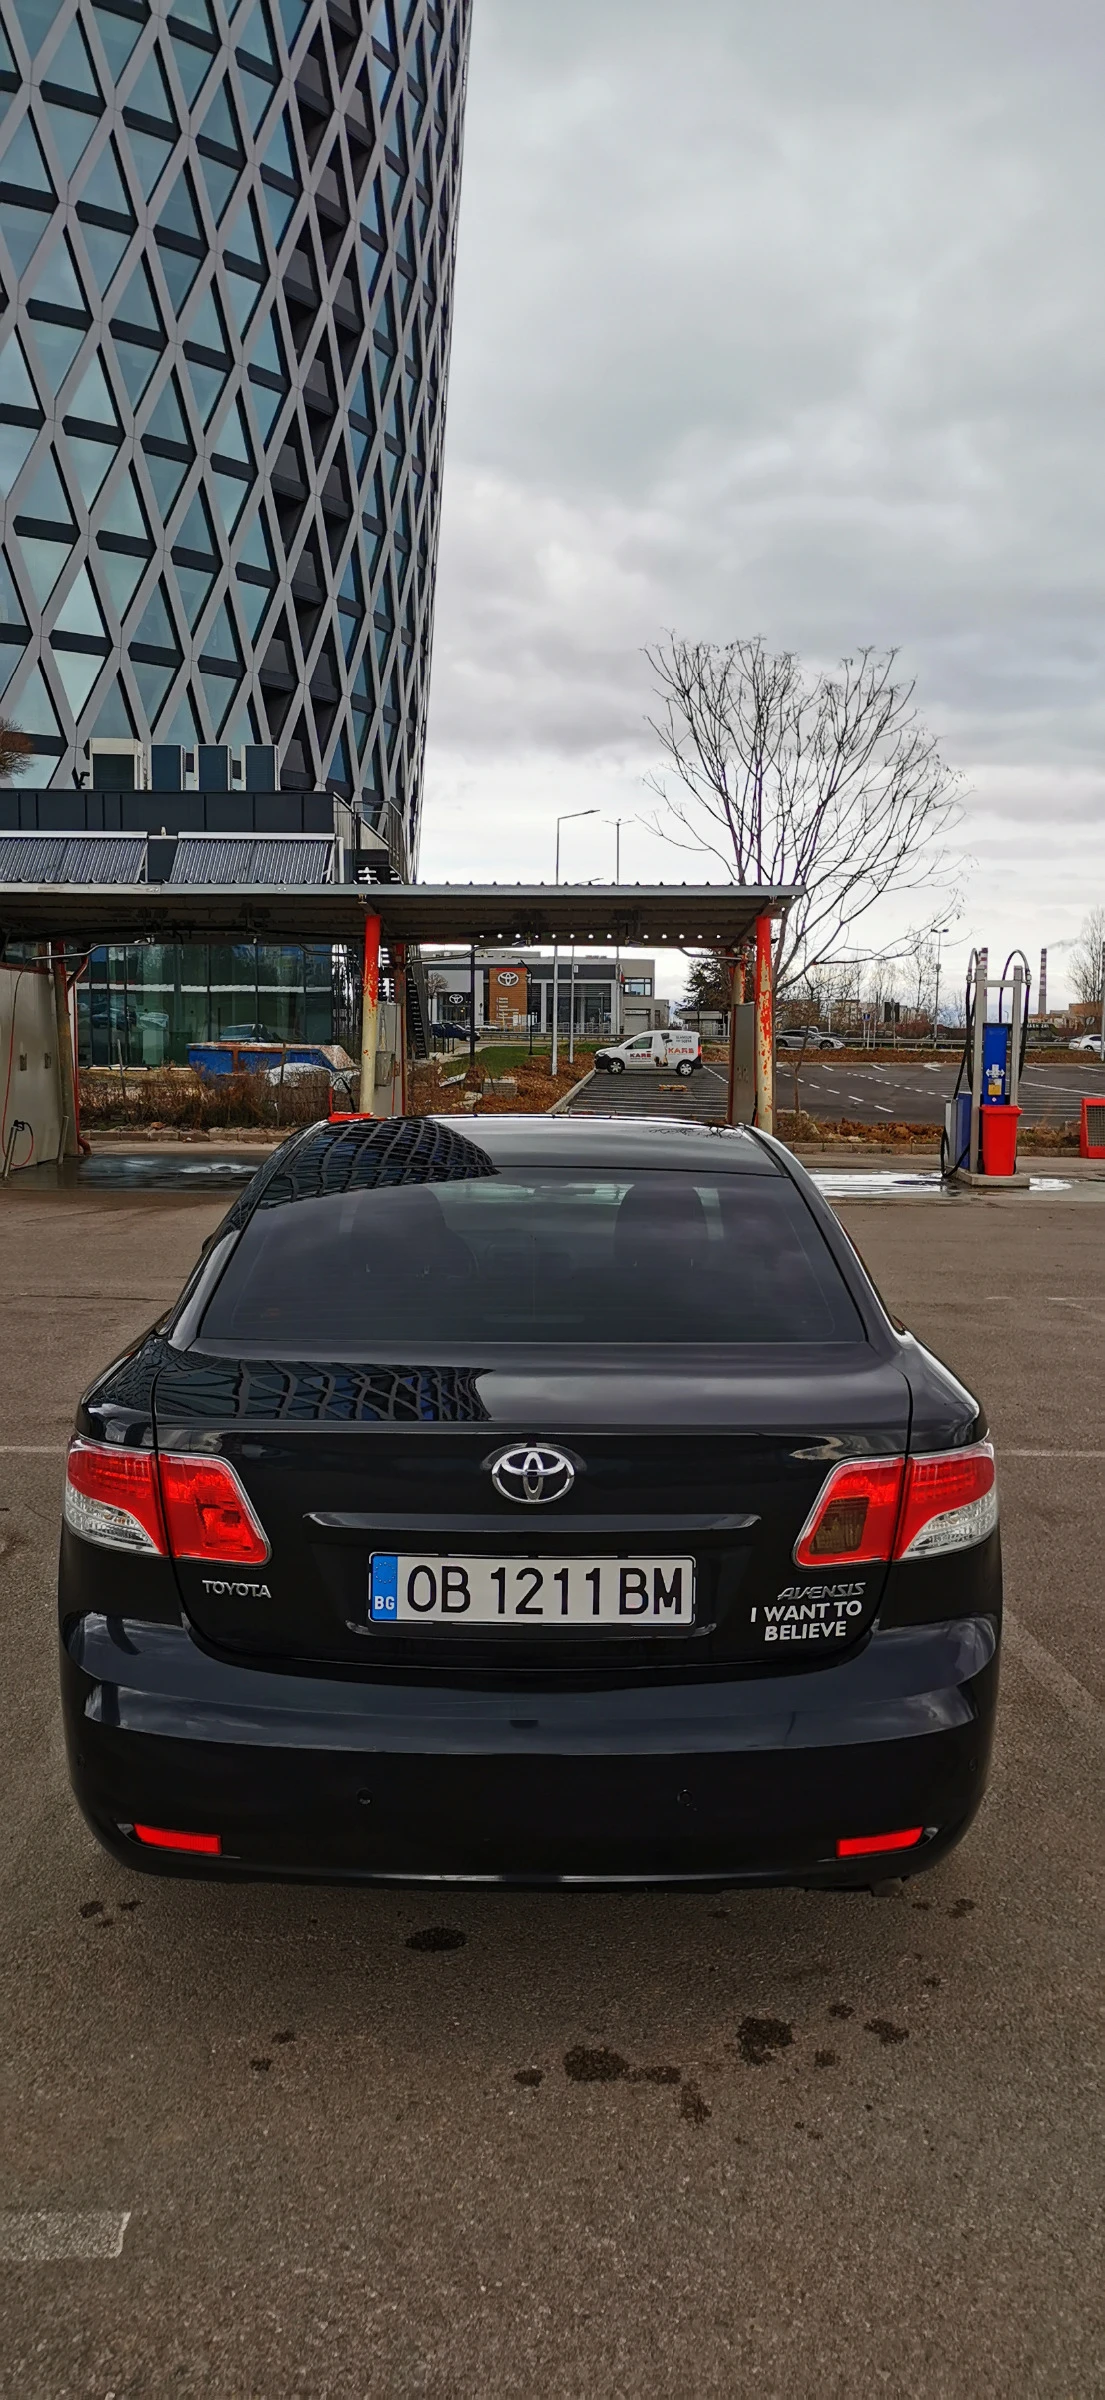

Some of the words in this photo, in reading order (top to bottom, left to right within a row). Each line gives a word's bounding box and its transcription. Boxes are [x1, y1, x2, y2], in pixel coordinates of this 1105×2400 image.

[202, 1580, 272, 1599] TOYOTA
[407, 1564, 471, 1613] OB
[490, 1566, 600, 1615] 1211
[618, 1567, 682, 1615] BM
[776, 1582, 867, 1601] AVENSIS
[374, 1595, 395, 1610] BG
[750, 1607, 757, 1622] I
[763, 1602, 831, 1622] WANT
[833, 1600, 863, 1618] TO
[764, 1620, 847, 1642] BELIEVE
